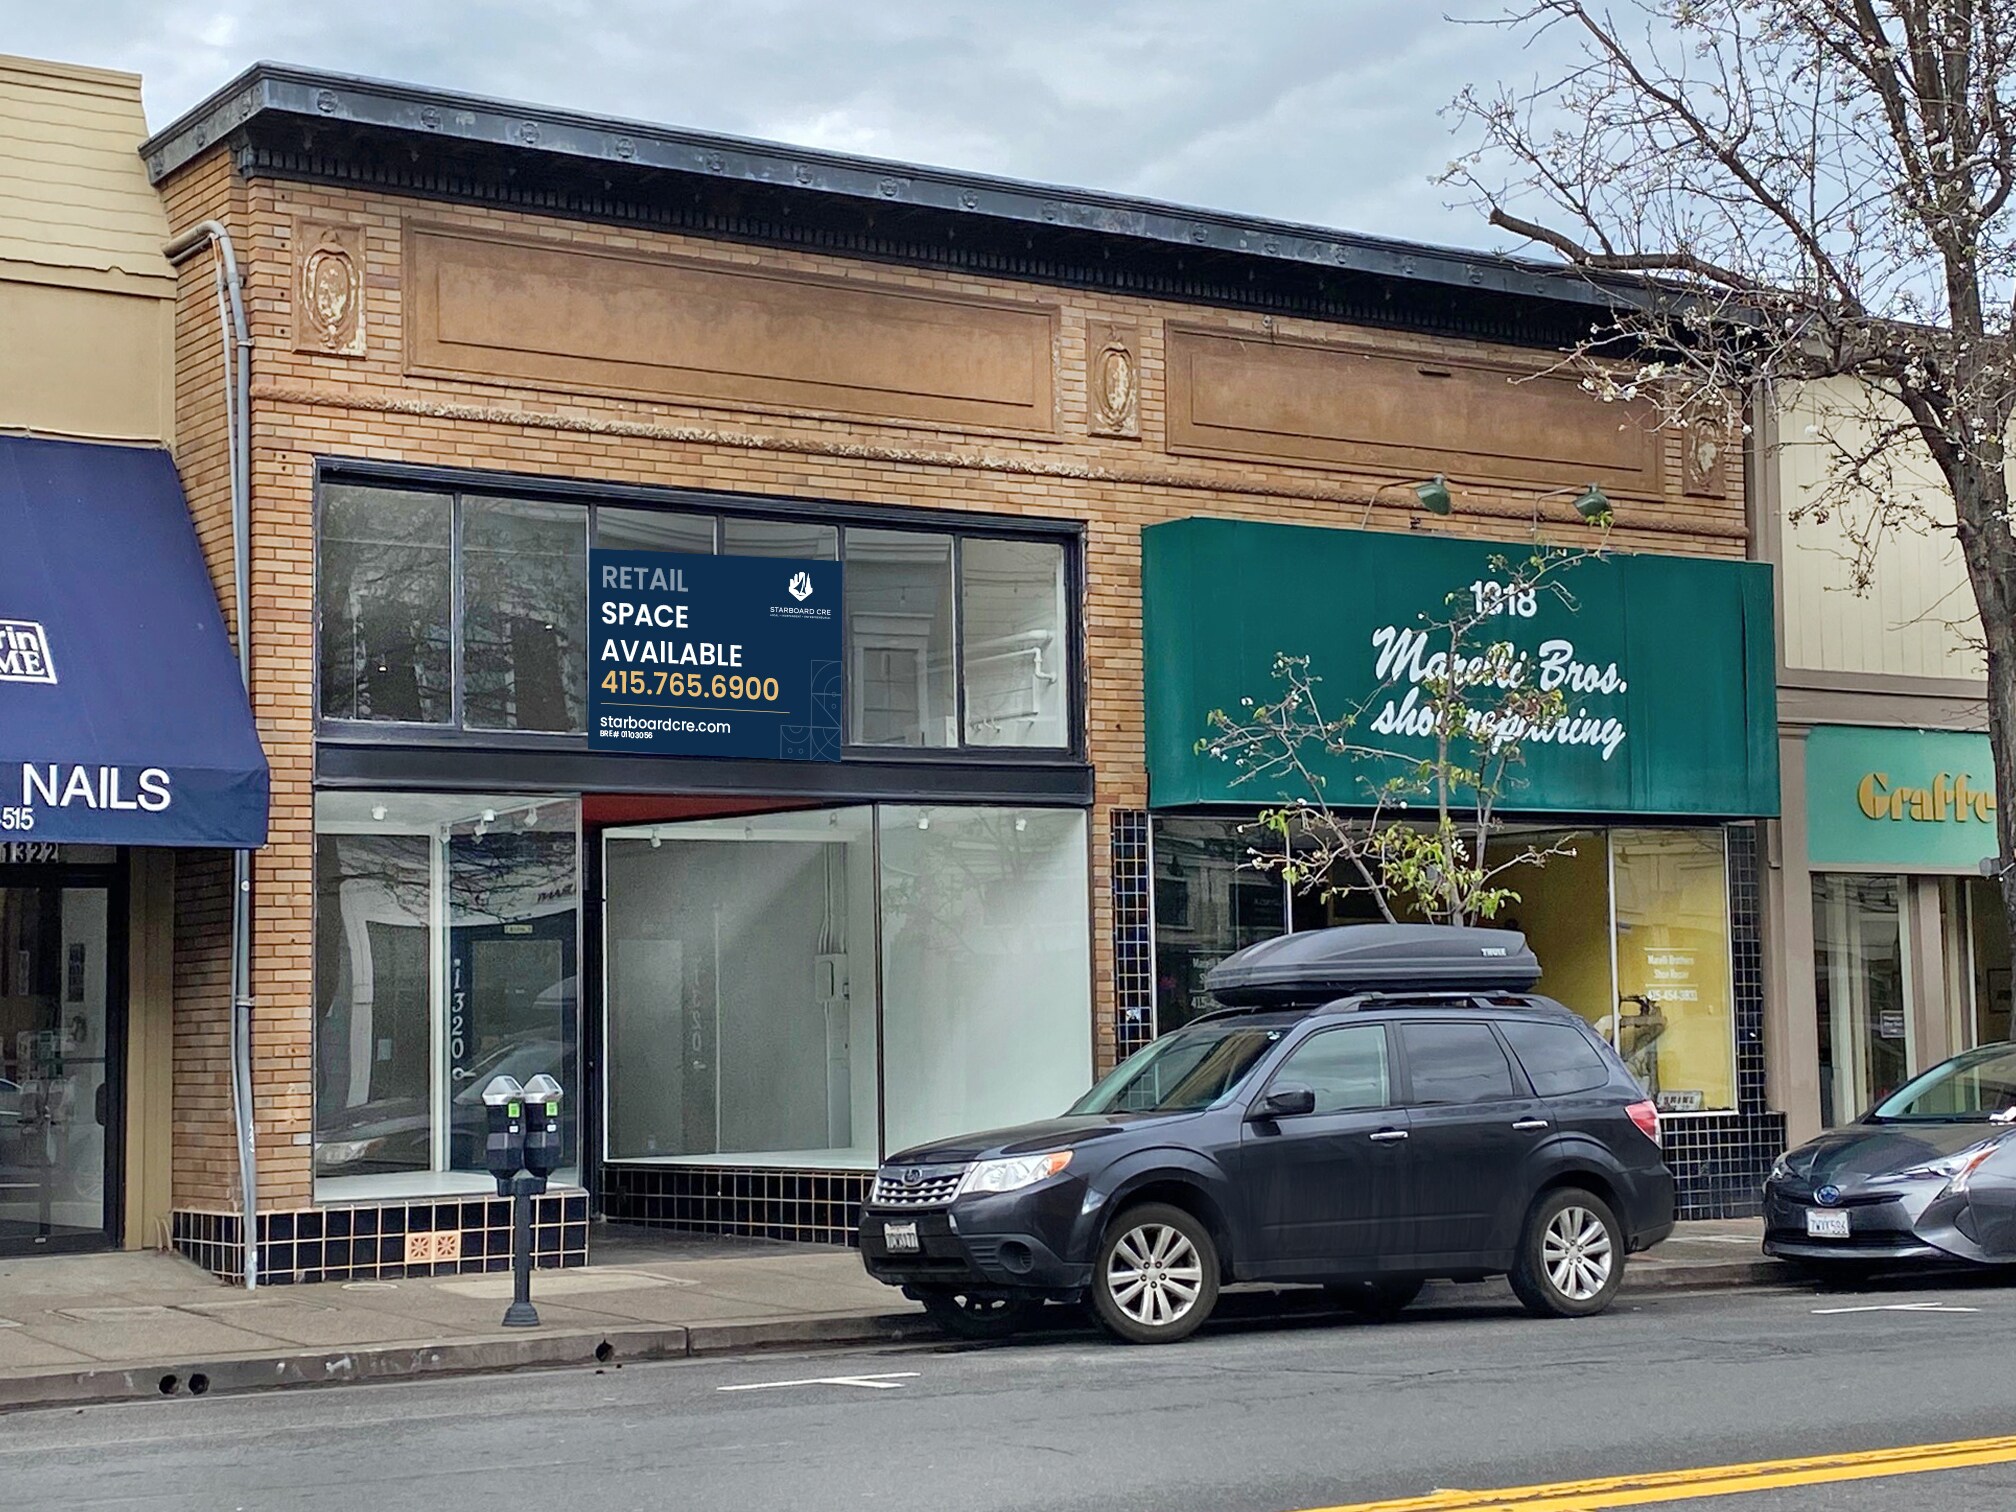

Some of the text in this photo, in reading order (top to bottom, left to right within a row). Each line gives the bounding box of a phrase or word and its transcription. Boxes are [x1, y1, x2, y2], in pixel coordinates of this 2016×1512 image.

[602, 565, 689, 592] RETAIL
[601, 601, 689, 628] SPACE
[770, 606, 832, 616] STARBOARD CRE
[601, 638, 743, 667] AVAILABLE
[1539, 639, 1628, 694] Bros.
[601, 670, 779, 701] 415.765.6900
[599, 730, 654, 739] BRE# 01103056
[600, 715, 731, 734] starboardcre.com
[23, 762, 171, 811] NAILS
[3, 842, 58, 863] 1322
[452, 968, 465, 1059] 1320
